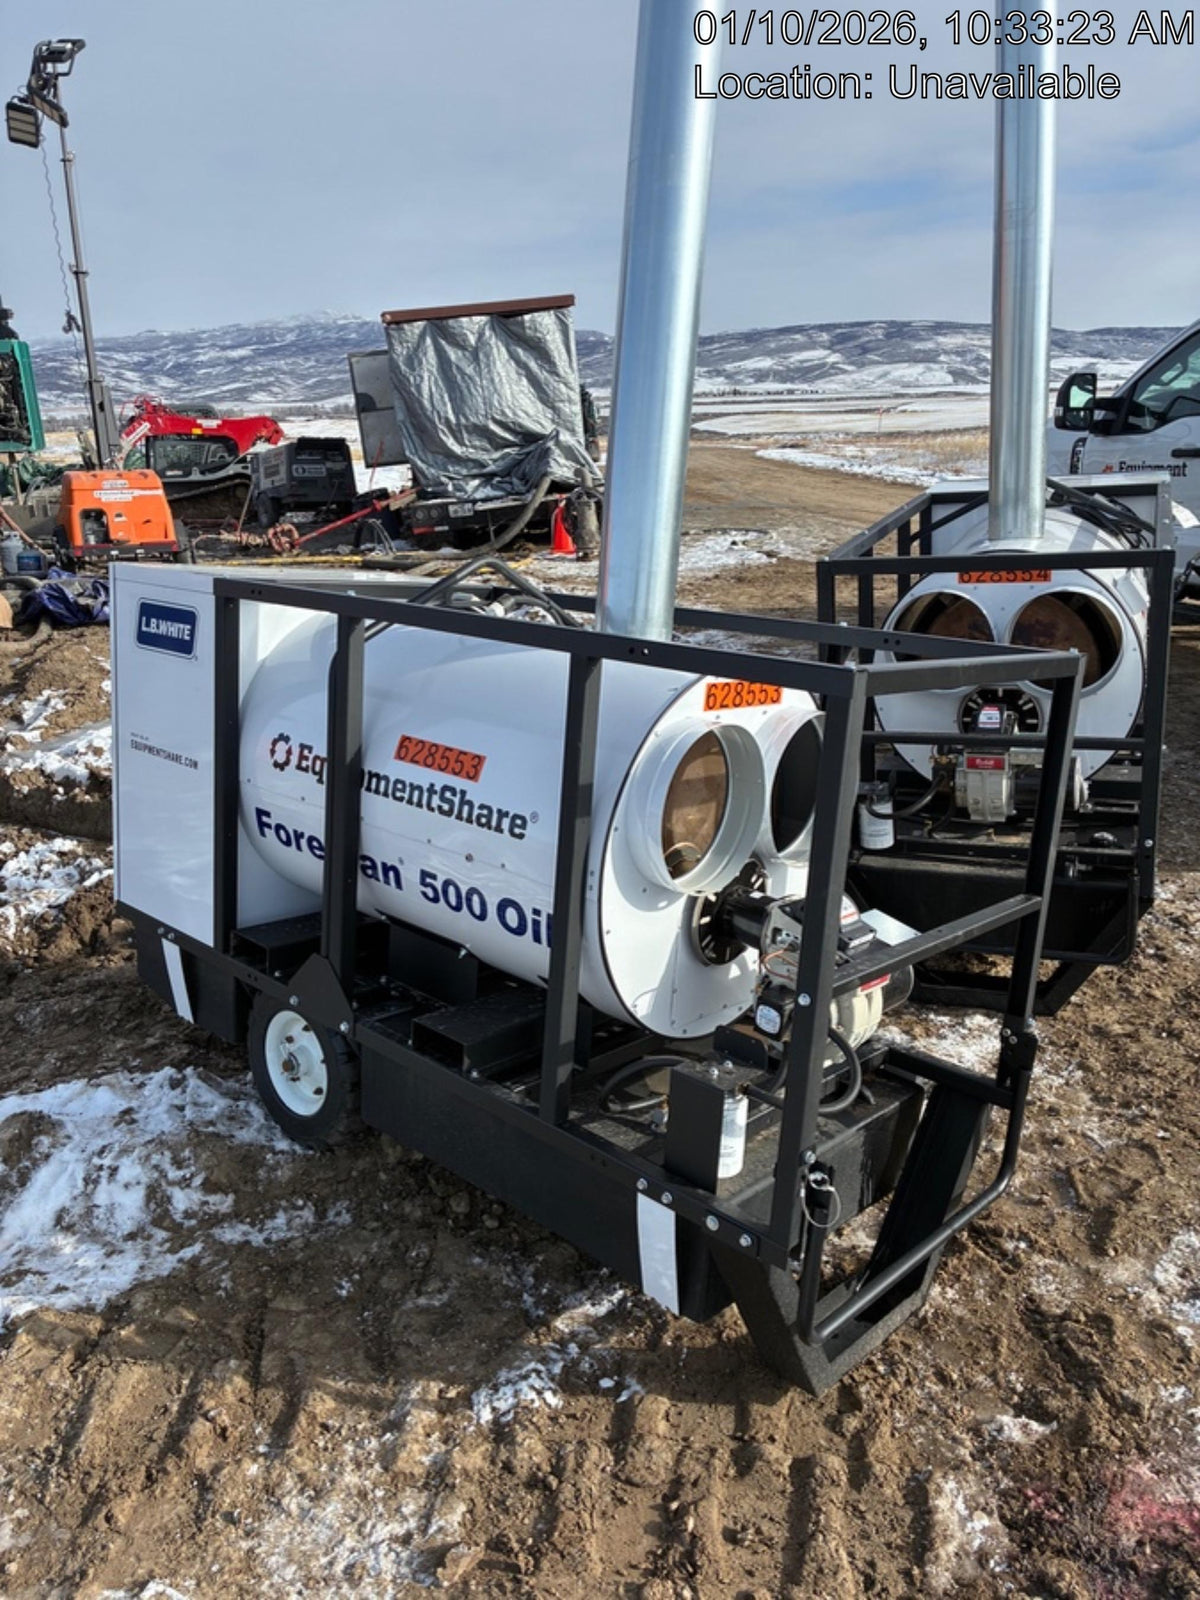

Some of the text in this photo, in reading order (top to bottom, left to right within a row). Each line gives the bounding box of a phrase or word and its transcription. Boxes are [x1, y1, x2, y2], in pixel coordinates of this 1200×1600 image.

[706, 682, 781, 710] 628553
[295, 742, 529, 840] EqmentShare
[396, 735, 484, 781] 628553
[255, 806, 404, 891] Forean
[418, 868, 488, 922] 500
